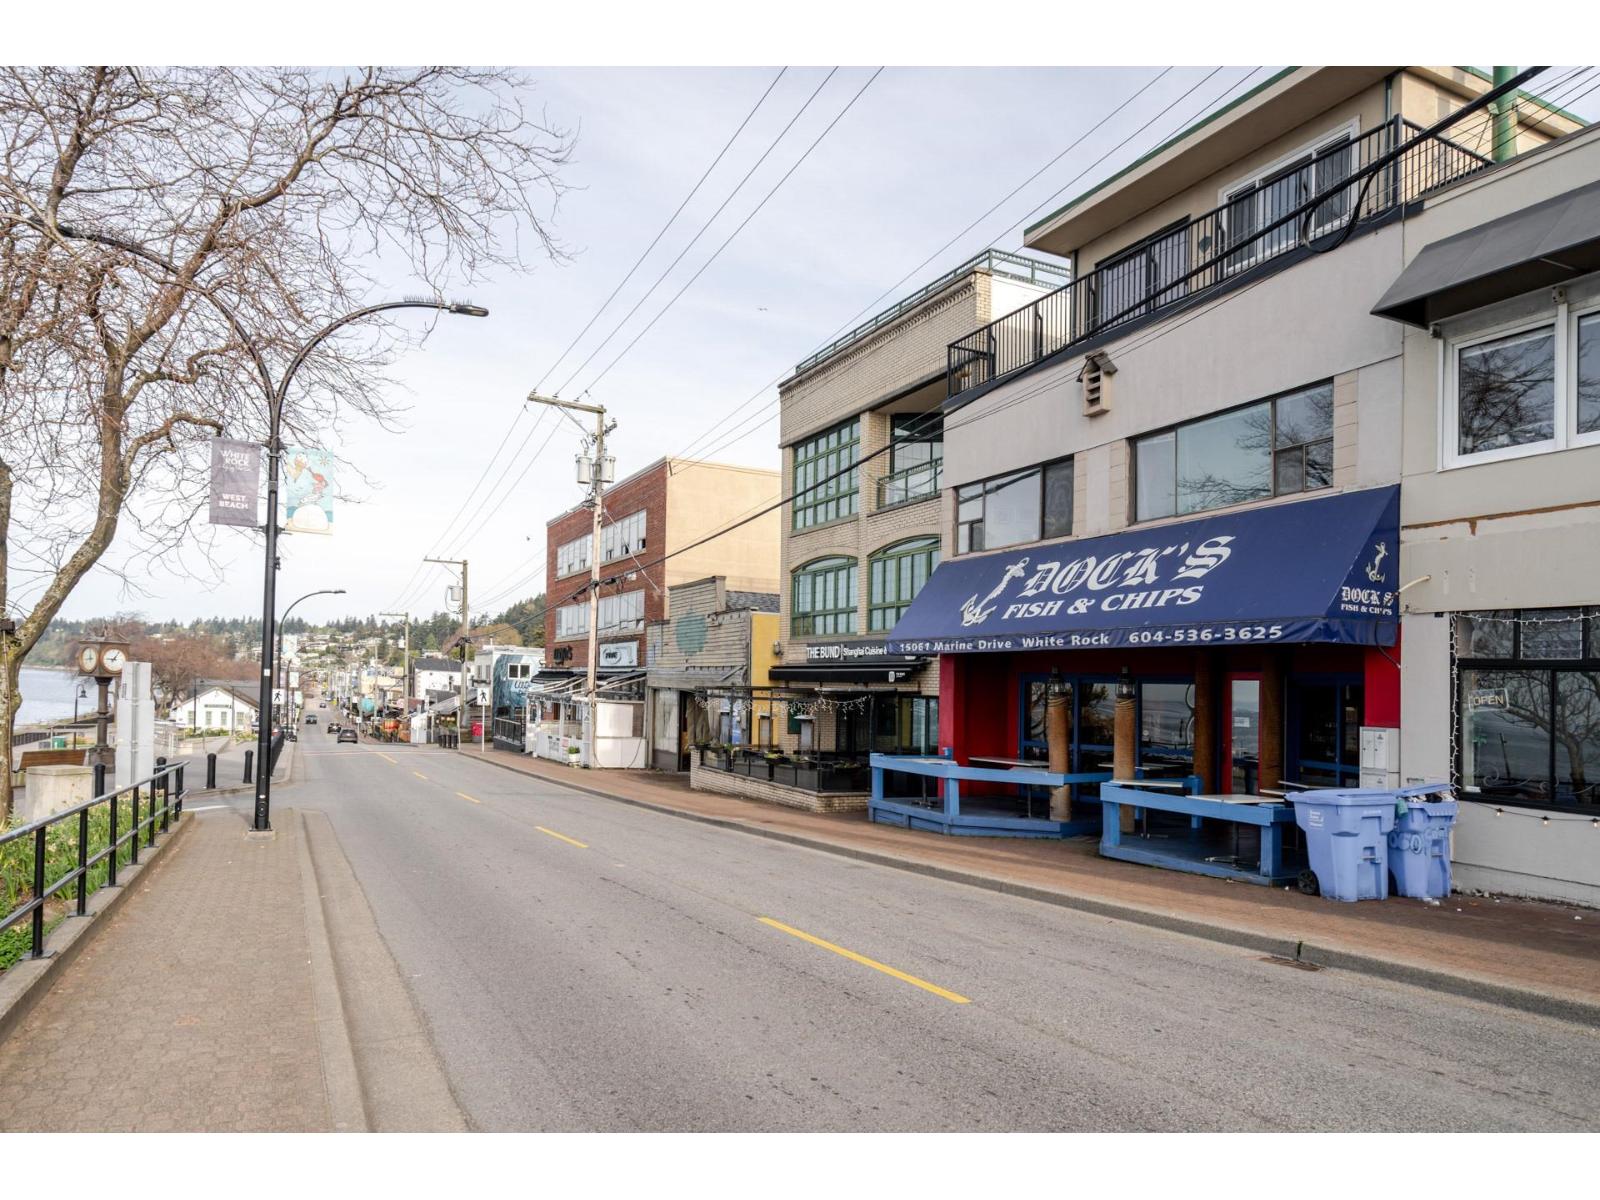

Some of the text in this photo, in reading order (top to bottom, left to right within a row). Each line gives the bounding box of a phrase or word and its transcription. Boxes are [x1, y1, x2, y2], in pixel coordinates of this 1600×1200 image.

[220, 449, 250, 460] WHITE
[225, 458, 249, 467] ROCK
[222, 493, 247, 502] WEST
[218, 500, 249, 510] BEACH
[1016, 535, 1237, 598] DOCK'S
[1001, 585, 1204, 620] FISH & CHIPS
[1341, 603, 1359, 612] FISH
[1360, 605, 1368, 613] &
[899, 625, 1283, 652] 15061 Marine Drive White Rock 604-536-3625
[806, 646, 819, 659] THE
[820, 645, 840, 659] BUND
[843, 647, 865, 658] Shanghai
[865, 645, 883, 656] Cuisine
[1474, 695, 1504, 706] OPEN
